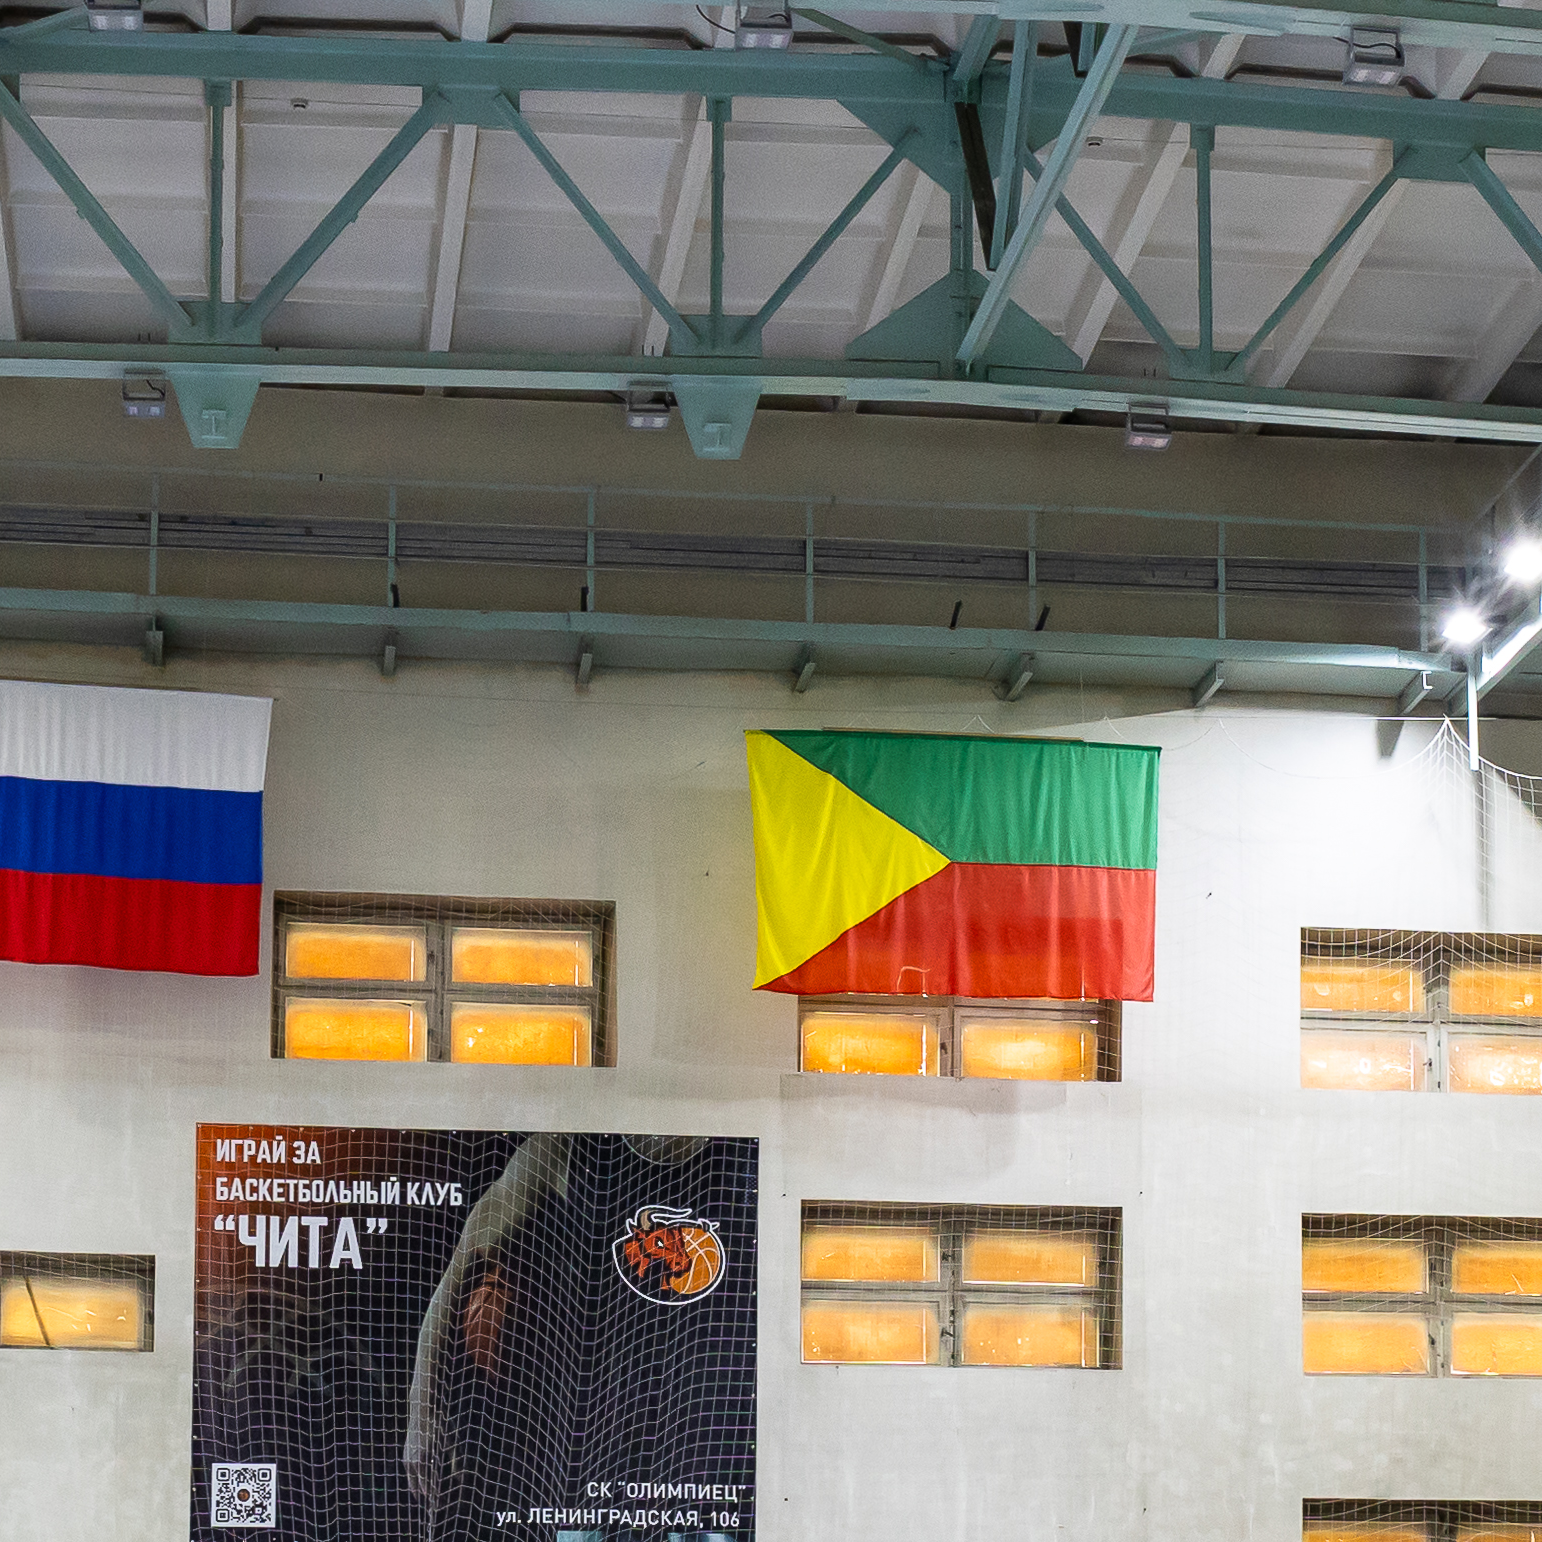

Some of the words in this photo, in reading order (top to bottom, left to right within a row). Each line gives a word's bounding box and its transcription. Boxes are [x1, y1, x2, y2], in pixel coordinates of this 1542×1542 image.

[216, 1135, 286, 1164] ИГРАЙ
[292, 1140, 322, 1165] ЗА
[215, 1176, 400, 1205] БАСКЕТБОЛЬНЫЙ
[407, 1181, 463, 1207] КЛУБ
[587, 1481, 613, 1498] СК
[496, 1510, 522, 1526] ул.
[527, 1508, 704, 1529] ЛЕНИНГРАДСКАЯ,
[710, 1511, 740, 1527] 106
